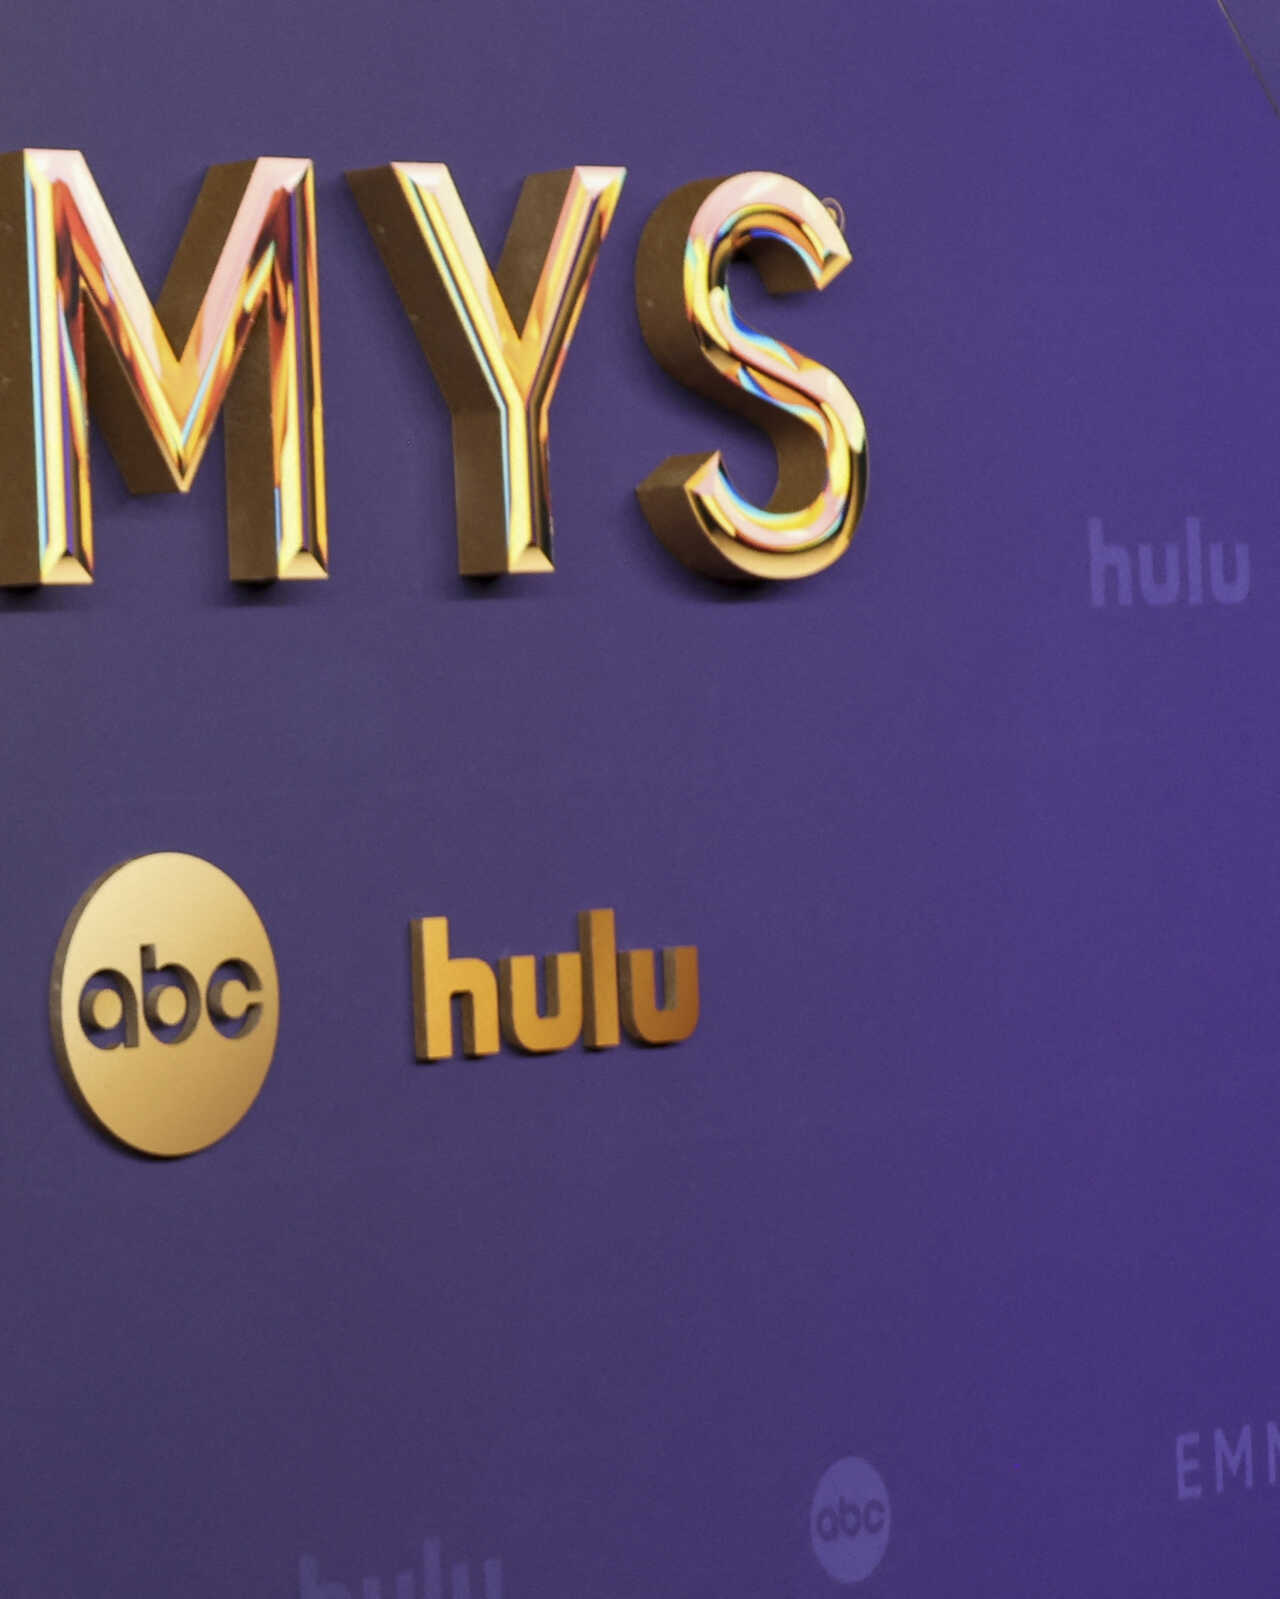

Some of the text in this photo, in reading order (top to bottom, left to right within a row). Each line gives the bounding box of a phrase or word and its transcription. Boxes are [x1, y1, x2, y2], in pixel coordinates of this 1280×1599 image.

[1089, 517, 1250, 607] hulu
[78, 944, 263, 1050] abc
[411, 908, 700, 1061] hulu
[817, 1496, 886, 1542] abc
